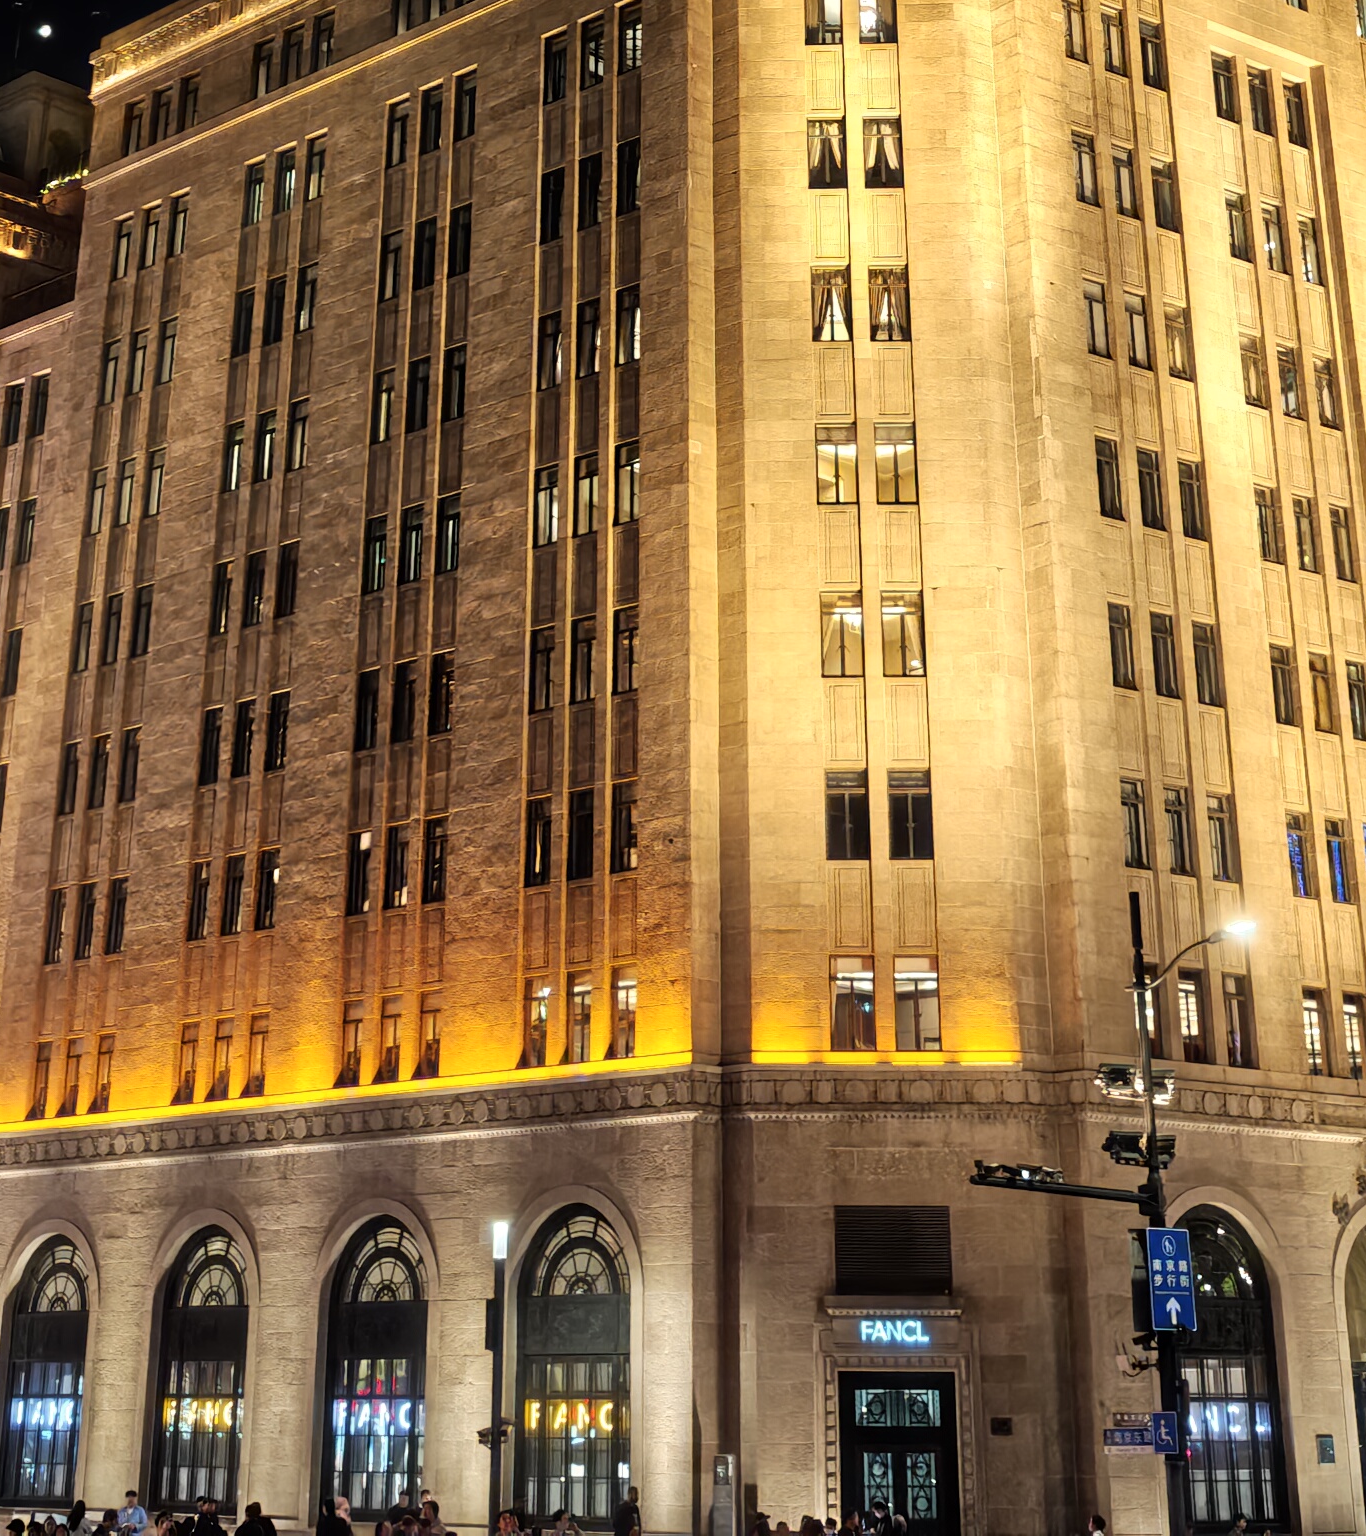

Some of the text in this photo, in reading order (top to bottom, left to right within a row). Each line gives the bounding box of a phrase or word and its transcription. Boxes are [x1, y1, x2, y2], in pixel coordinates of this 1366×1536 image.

[1152, 1259, 1188, 1272] 南京路
[1153, 1274, 1190, 1288] 步行街
[860, 1319, 930, 1343] FANCL
